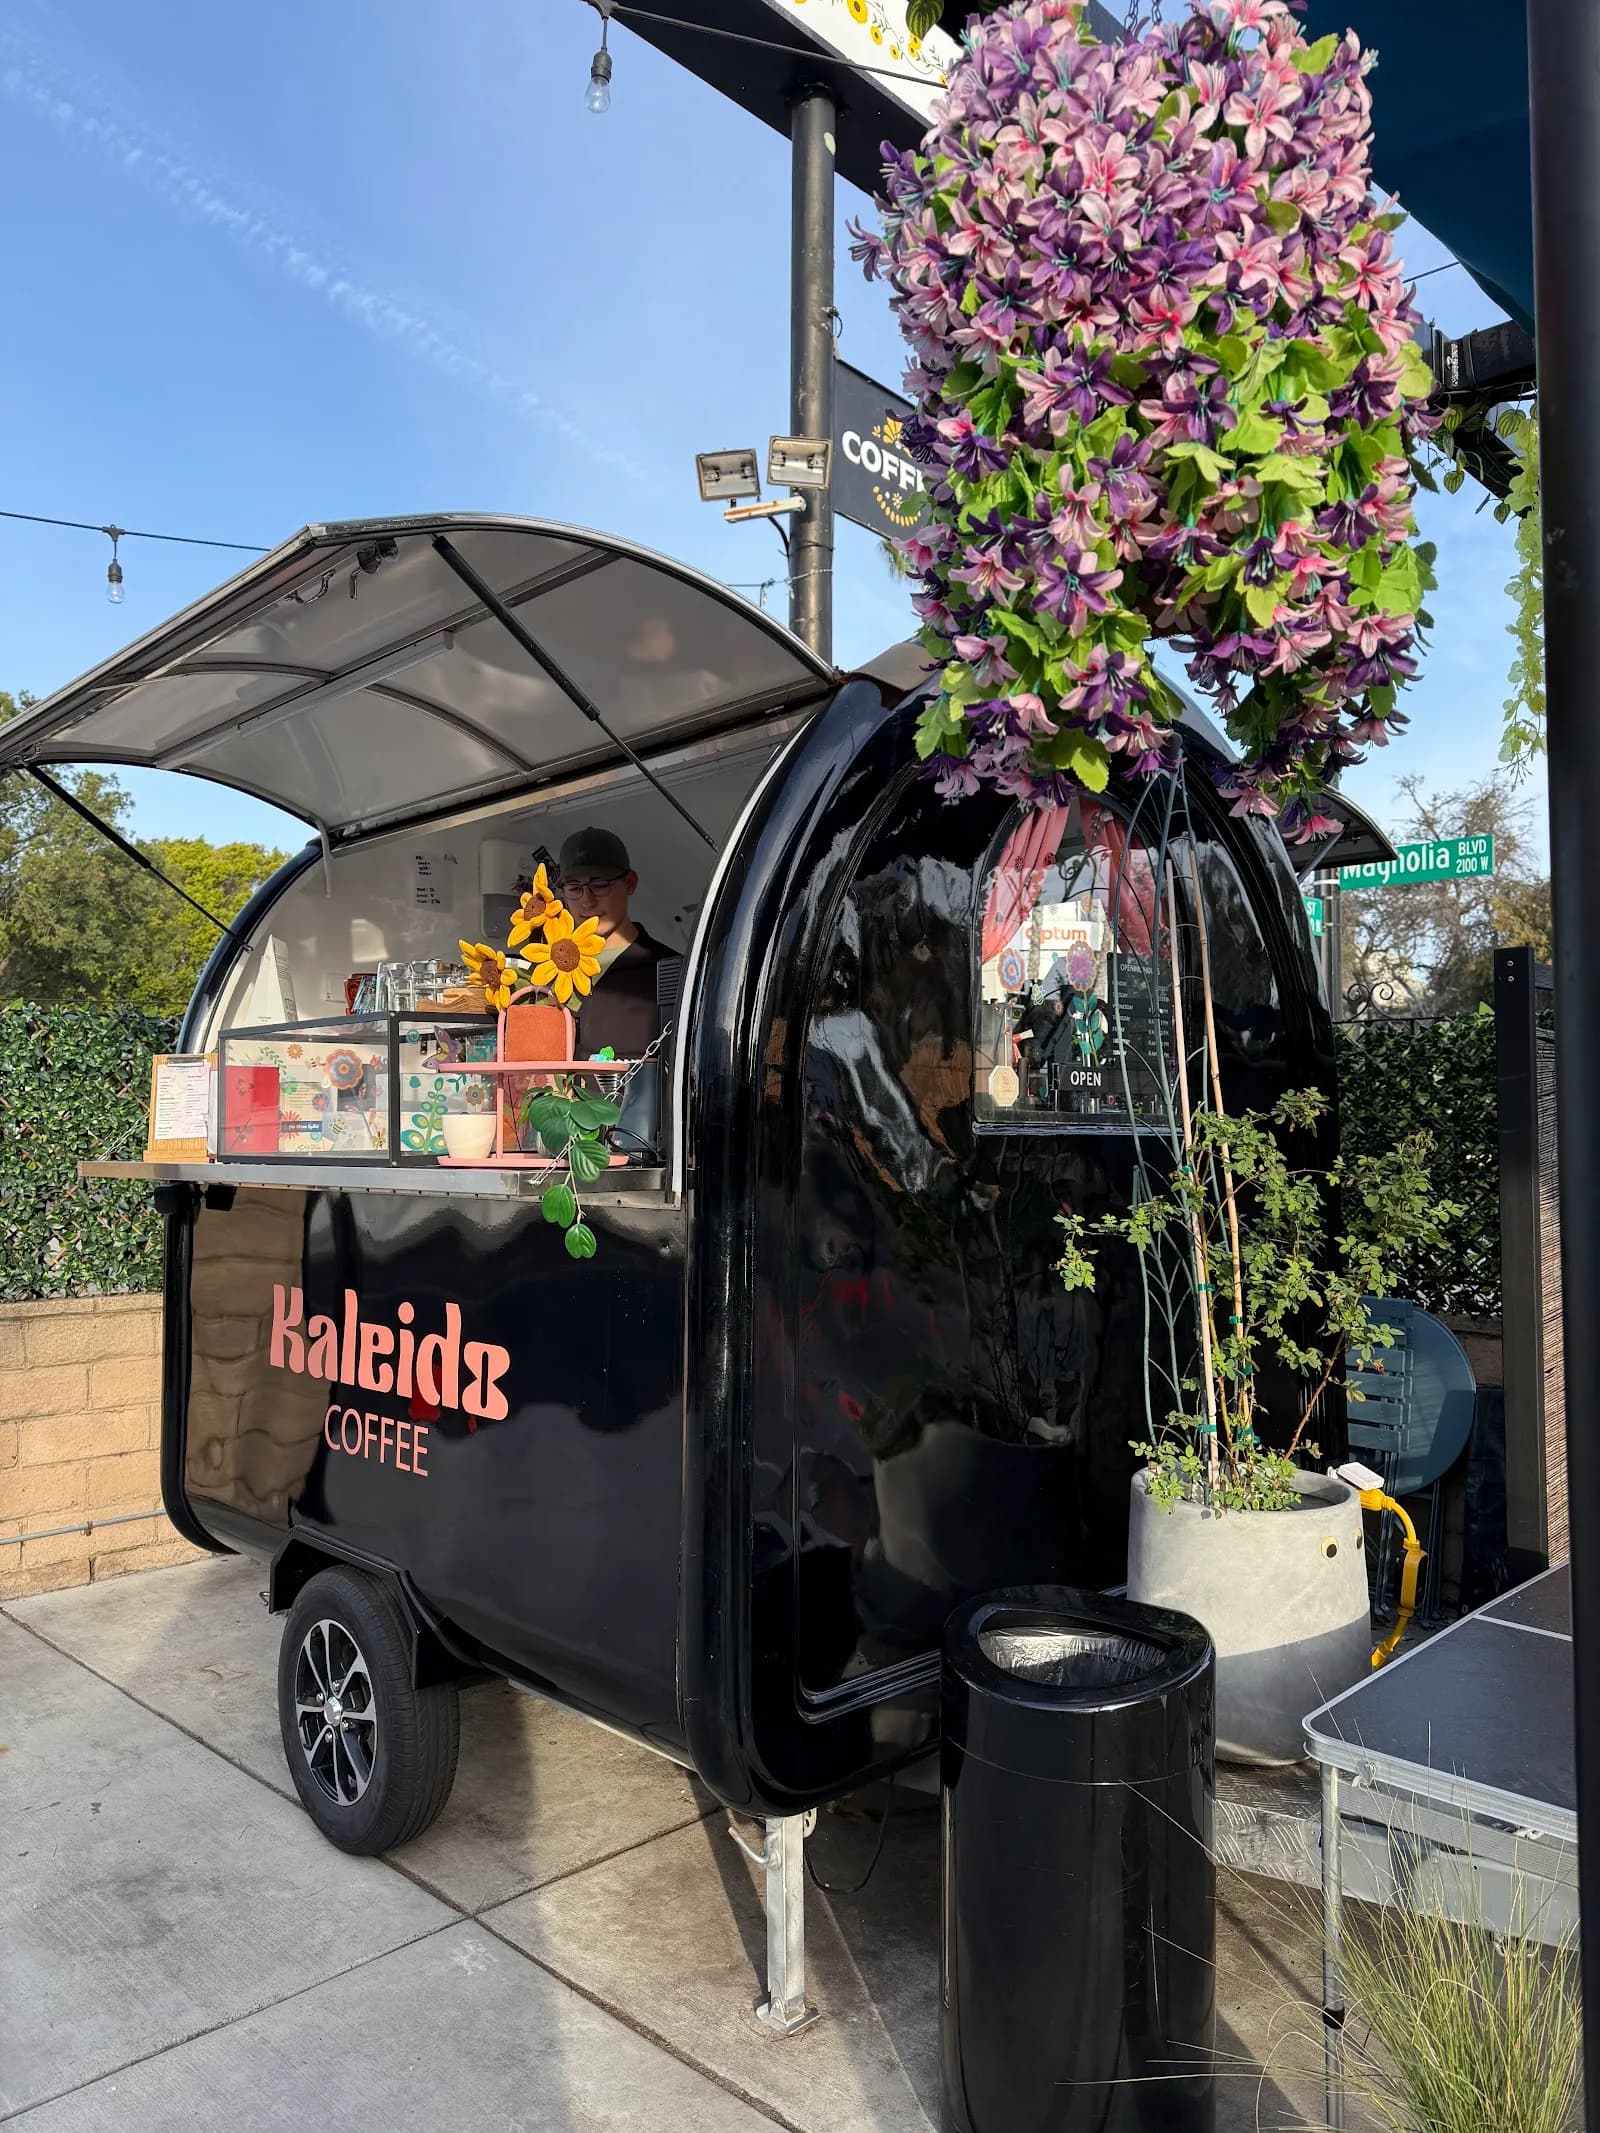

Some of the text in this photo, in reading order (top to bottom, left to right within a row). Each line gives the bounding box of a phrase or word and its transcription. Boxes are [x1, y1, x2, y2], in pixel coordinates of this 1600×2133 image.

[1458, 839, 1487, 856] BLVD
[1455, 855, 1489, 874] 2100 W
[1306, 901, 1317, 916] ST
[1070, 1070, 1102, 1087] OPEN
[324, 1404, 429, 1477] COFFEE
